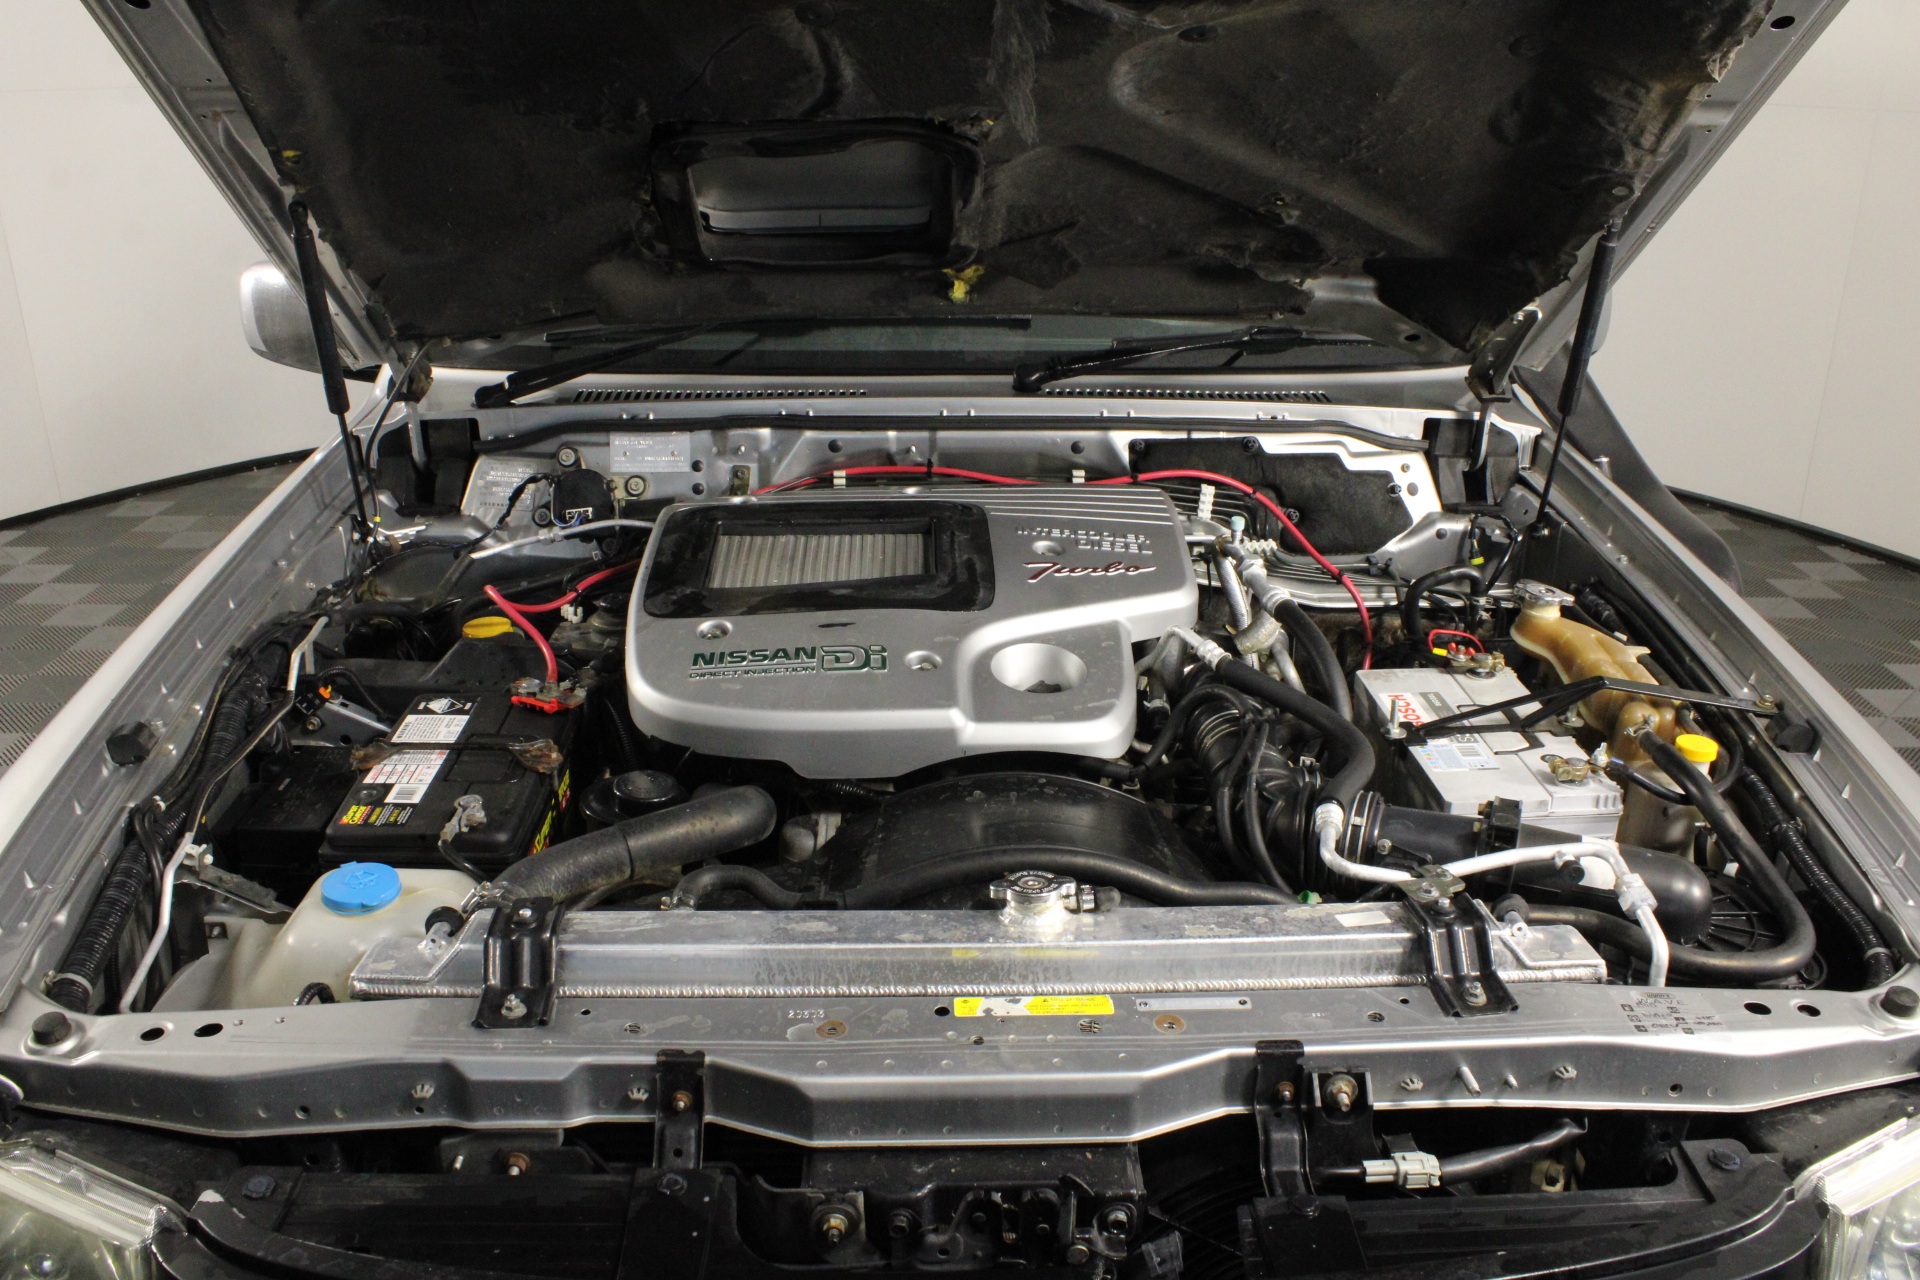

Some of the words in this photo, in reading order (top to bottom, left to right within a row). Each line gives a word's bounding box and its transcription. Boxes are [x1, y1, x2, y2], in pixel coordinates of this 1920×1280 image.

[1015, 526, 1150, 543] INTERCOOLER
[1075, 539, 1153, 554] DIESEL
[1022, 561, 1157, 583] Turbo
[692, 646, 817, 667] NISSAN
[820, 644, 888, 673] Di
[689, 669, 741, 681] DIRECT
[744, 666, 817, 677] INJECTION
